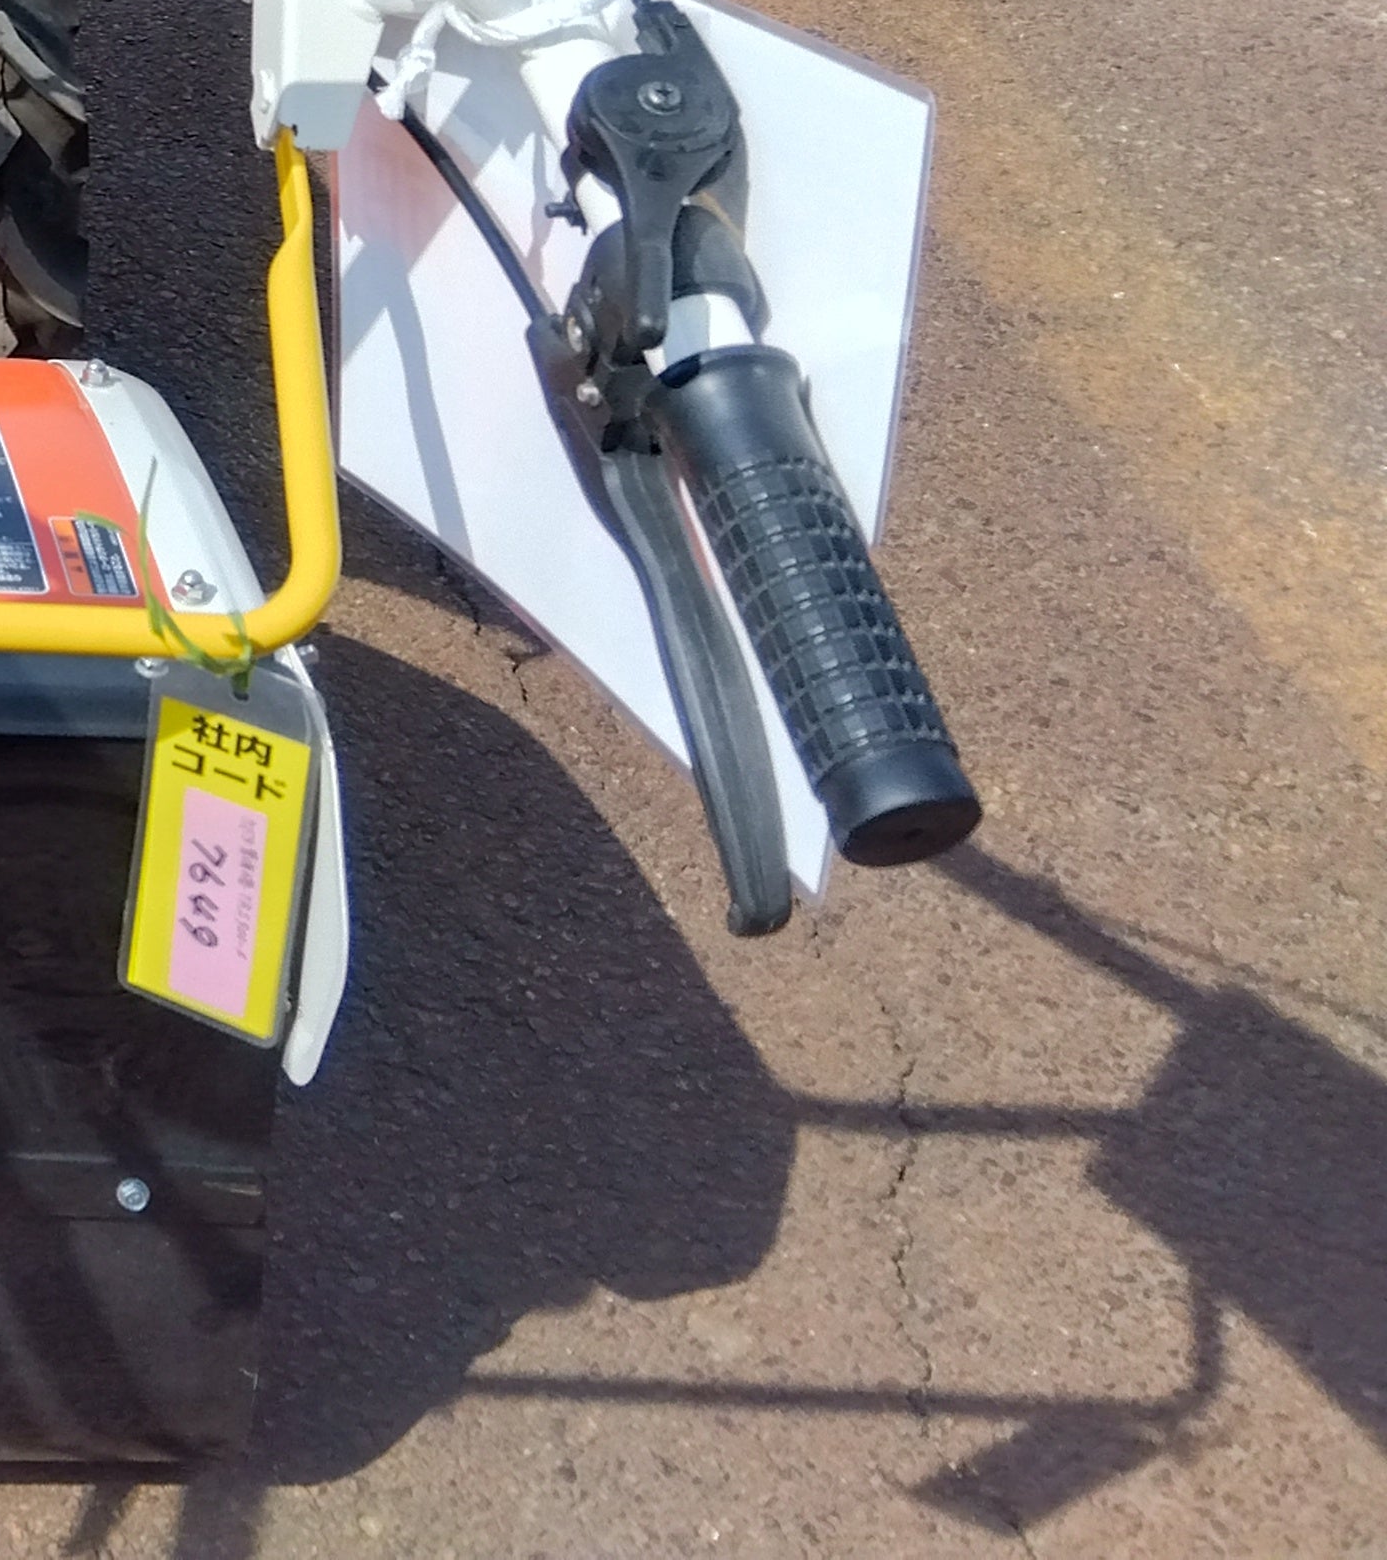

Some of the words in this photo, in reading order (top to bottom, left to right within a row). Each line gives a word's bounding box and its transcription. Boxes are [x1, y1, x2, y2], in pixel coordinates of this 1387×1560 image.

[191, 714, 273, 768] 社内
[171, 743, 287, 801] コード
[178, 838, 227, 948] 7649
